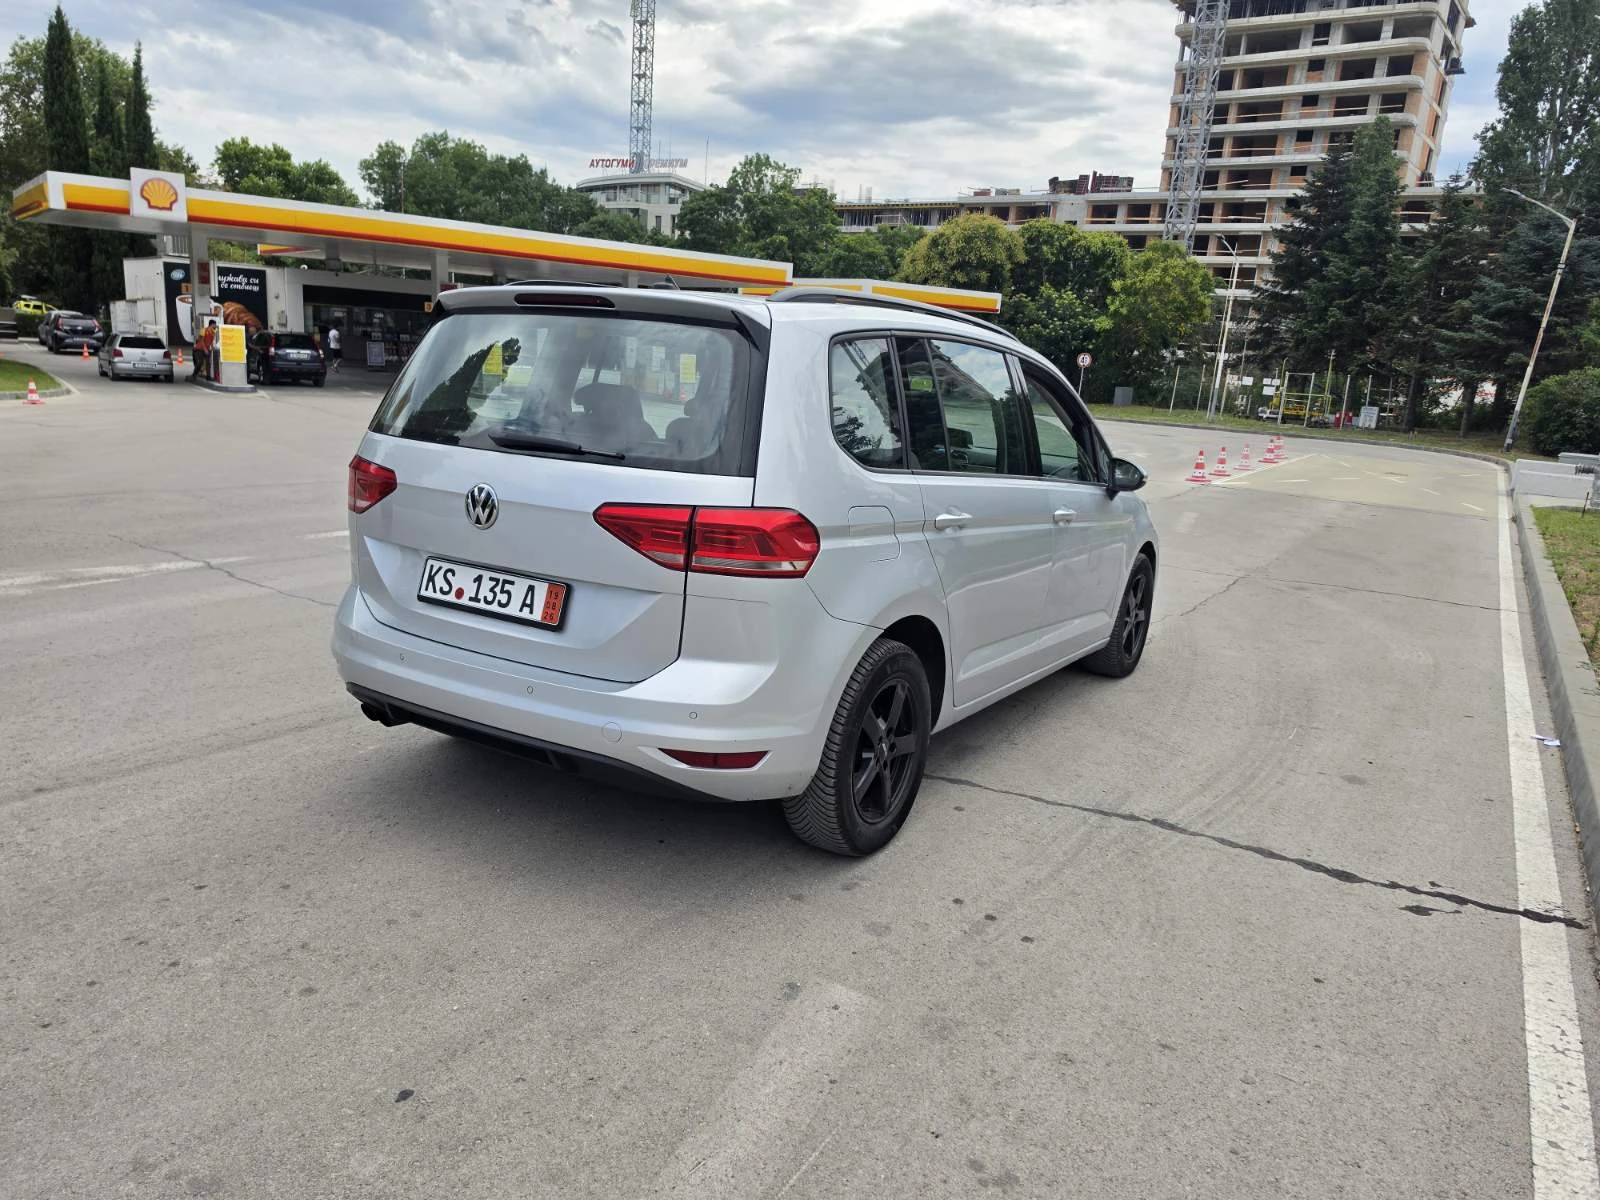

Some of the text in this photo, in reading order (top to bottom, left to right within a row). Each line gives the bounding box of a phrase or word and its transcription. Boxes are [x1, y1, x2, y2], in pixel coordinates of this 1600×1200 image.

[644, 158, 688, 168] РЕМИУМ
[424, 563, 536, 615] KS 135 A
[549, 590, 559, 600] 19
